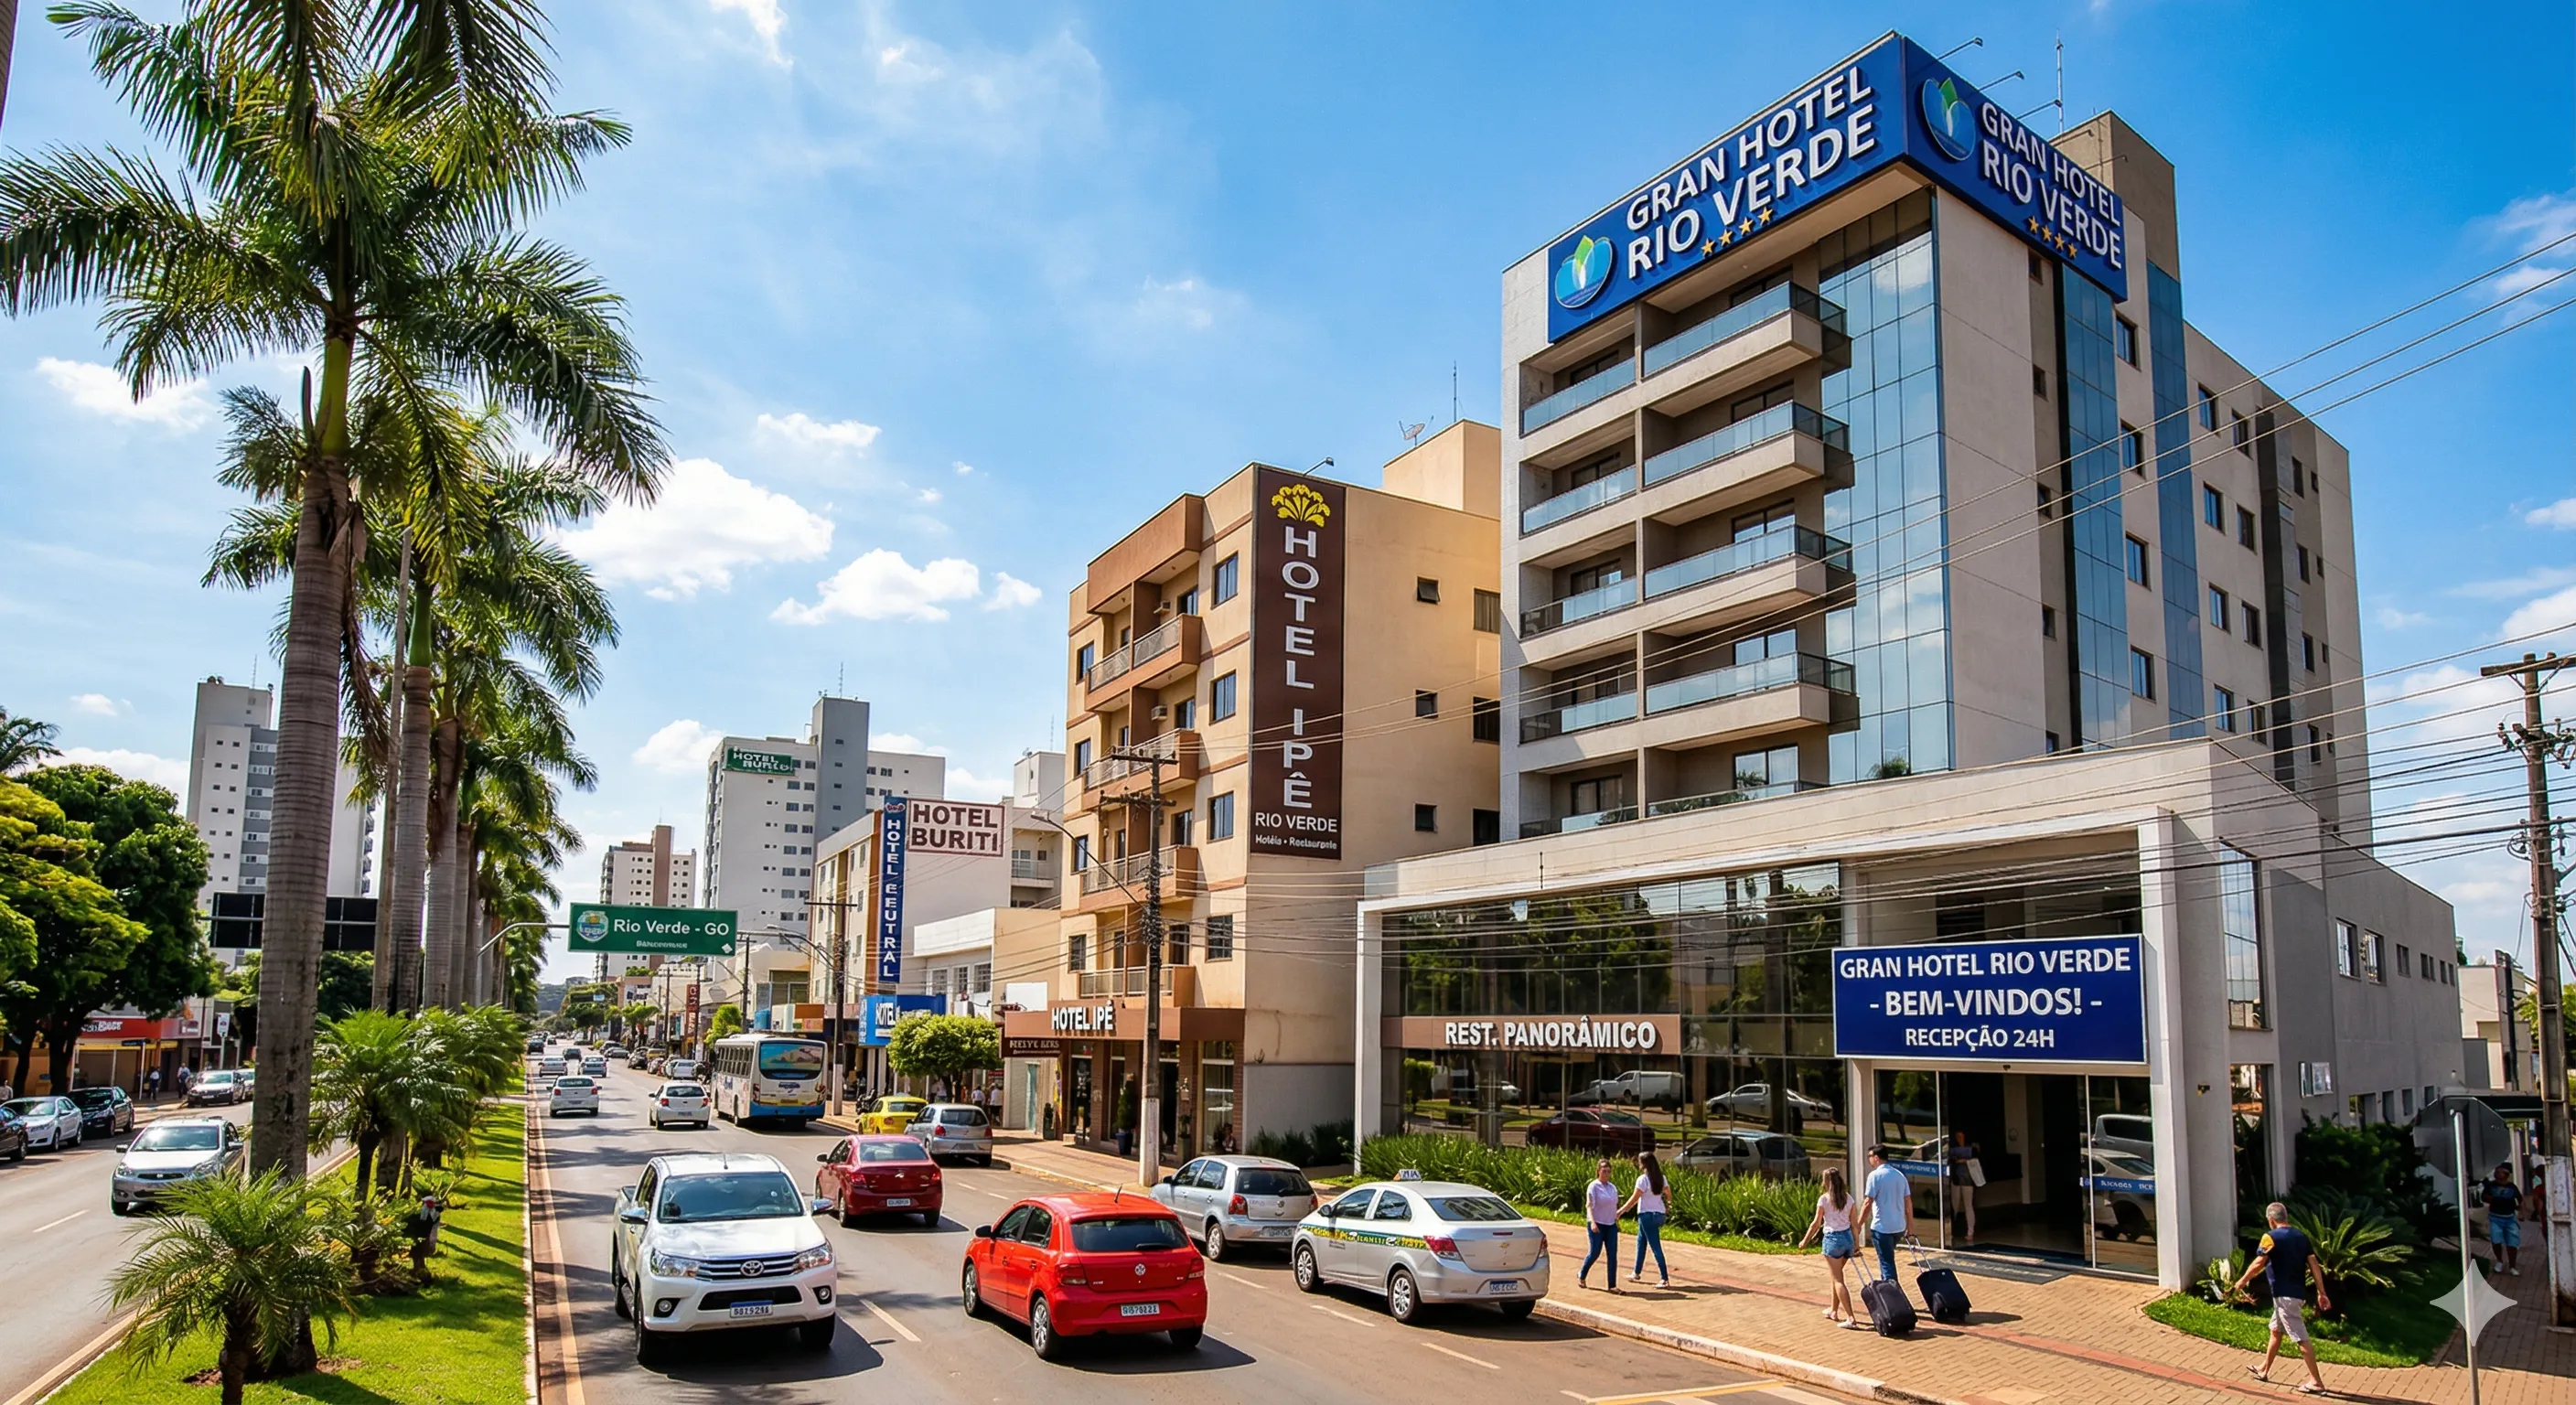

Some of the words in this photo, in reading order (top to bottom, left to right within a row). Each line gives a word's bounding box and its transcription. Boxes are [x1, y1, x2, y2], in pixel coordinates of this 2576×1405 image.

[1626, 147, 1726, 231] GRAN
[1739, 66, 1872, 169] HOTEL
[1981, 102, 2047, 172] GRAN
[2054, 152, 2120, 227] HOTEL
[1627, 209, 1700, 280] RIO
[1712, 103, 1875, 226] VERDE
[1983, 139, 2033, 205] RIO
[2040, 178, 2122, 270] VERDE
[1282, 525, 1320, 690] HOTEL
[733, 752, 779, 764] HOTEL
[1283, 708, 1314, 809] IPÊ
[912, 803, 999, 829] HOTEL
[1255, 811, 1282, 829] RIO
[1285, 814, 1338, 833] VERDE
[886, 820, 901, 875] HOTEL
[911, 827, 998, 852] BURITI
[614, 918, 641, 933] Rio
[645, 919, 691, 935] Verde
[704, 922, 730, 937] GO
[1840, 956, 1902, 980] GRAN
[1907, 953, 1984, 978] HOTEL
[1990, 951, 2034, 976] RIO
[2038, 947, 2131, 973] VERDE
[1051, 1006, 1090, 1031] HOTEL
[1092, 999, 1113, 1031] IPÊ
[1884, 987, 2083, 1016] BEM-VINDOS!
[1444, 1022, 1499, 1046] REST.
[1503, 1014, 1657, 1049] PANORÂMICO
[1905, 1024, 2009, 1052] RECEPÇÃO
[2012, 1028, 2055, 1048] 24H
